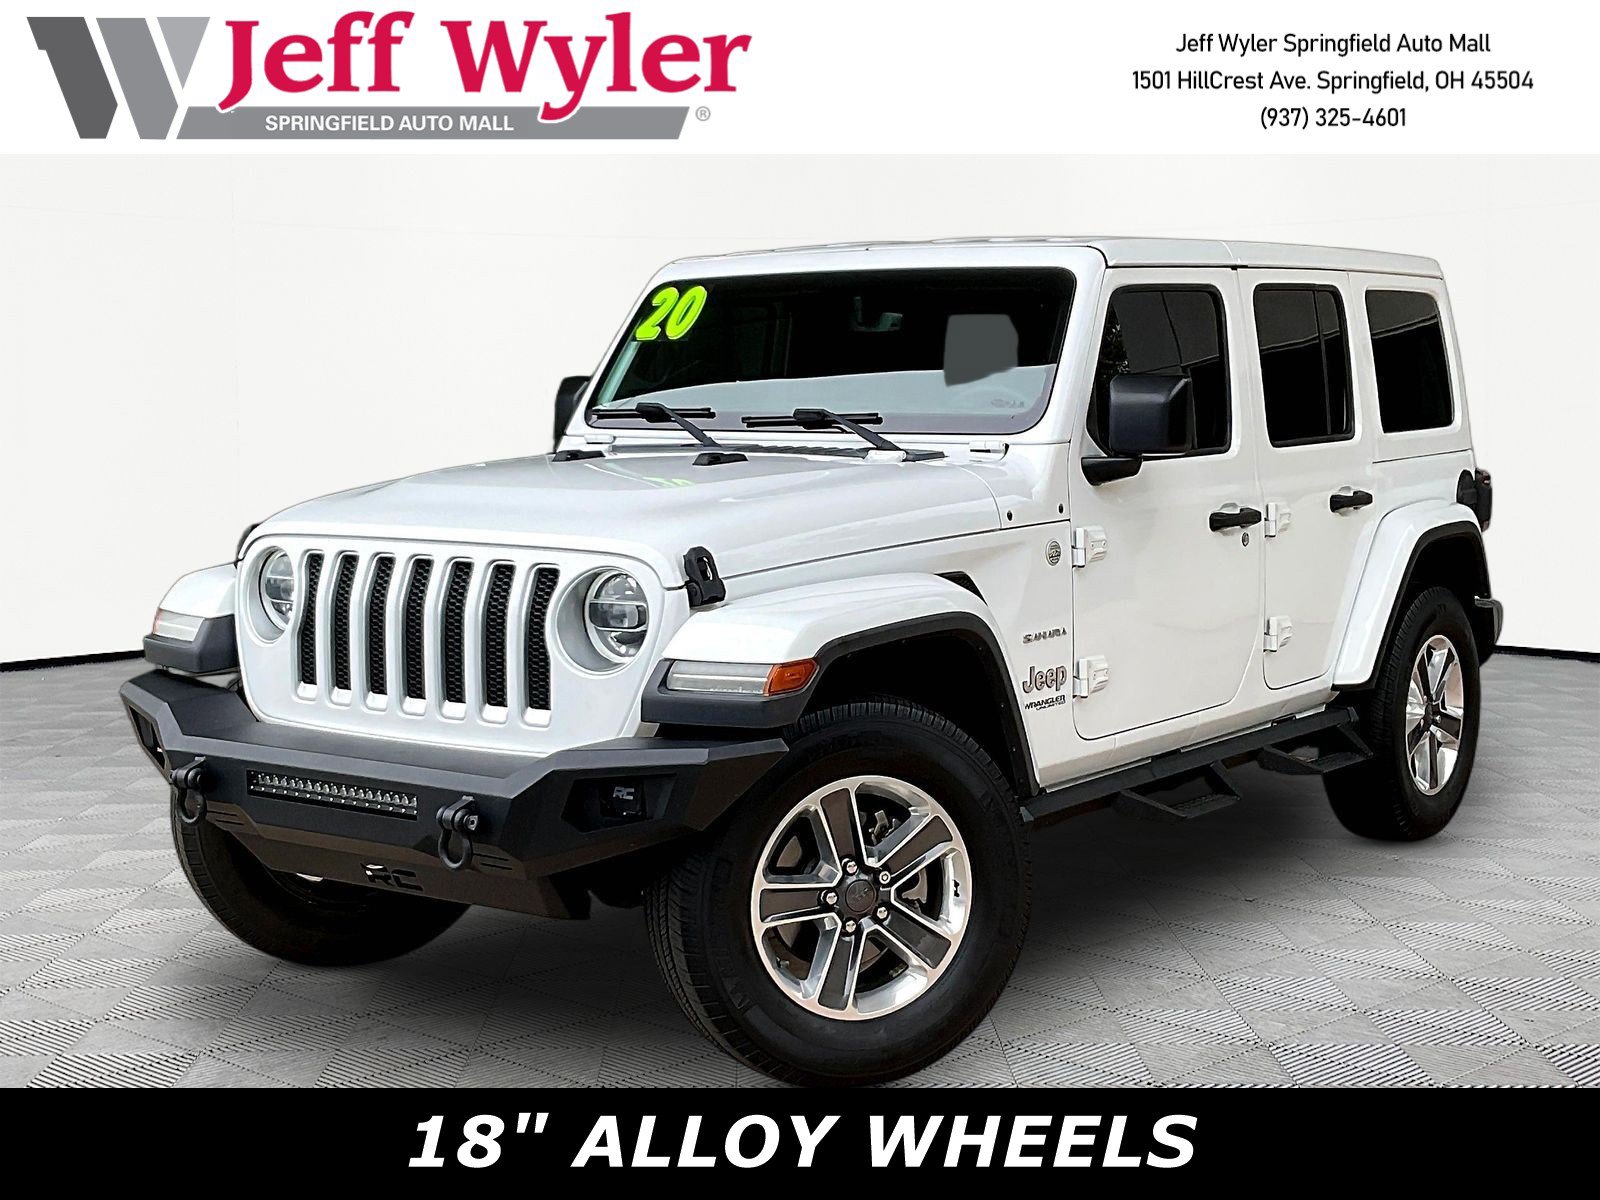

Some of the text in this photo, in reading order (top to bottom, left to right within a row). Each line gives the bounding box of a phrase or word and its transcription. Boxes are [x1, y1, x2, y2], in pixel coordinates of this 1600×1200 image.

[635, 285, 708, 341] 20
[1023, 665, 1067, 693] Jeep
[1025, 695, 1066, 710] WRANGLER
[613, 786, 635, 801] RC
